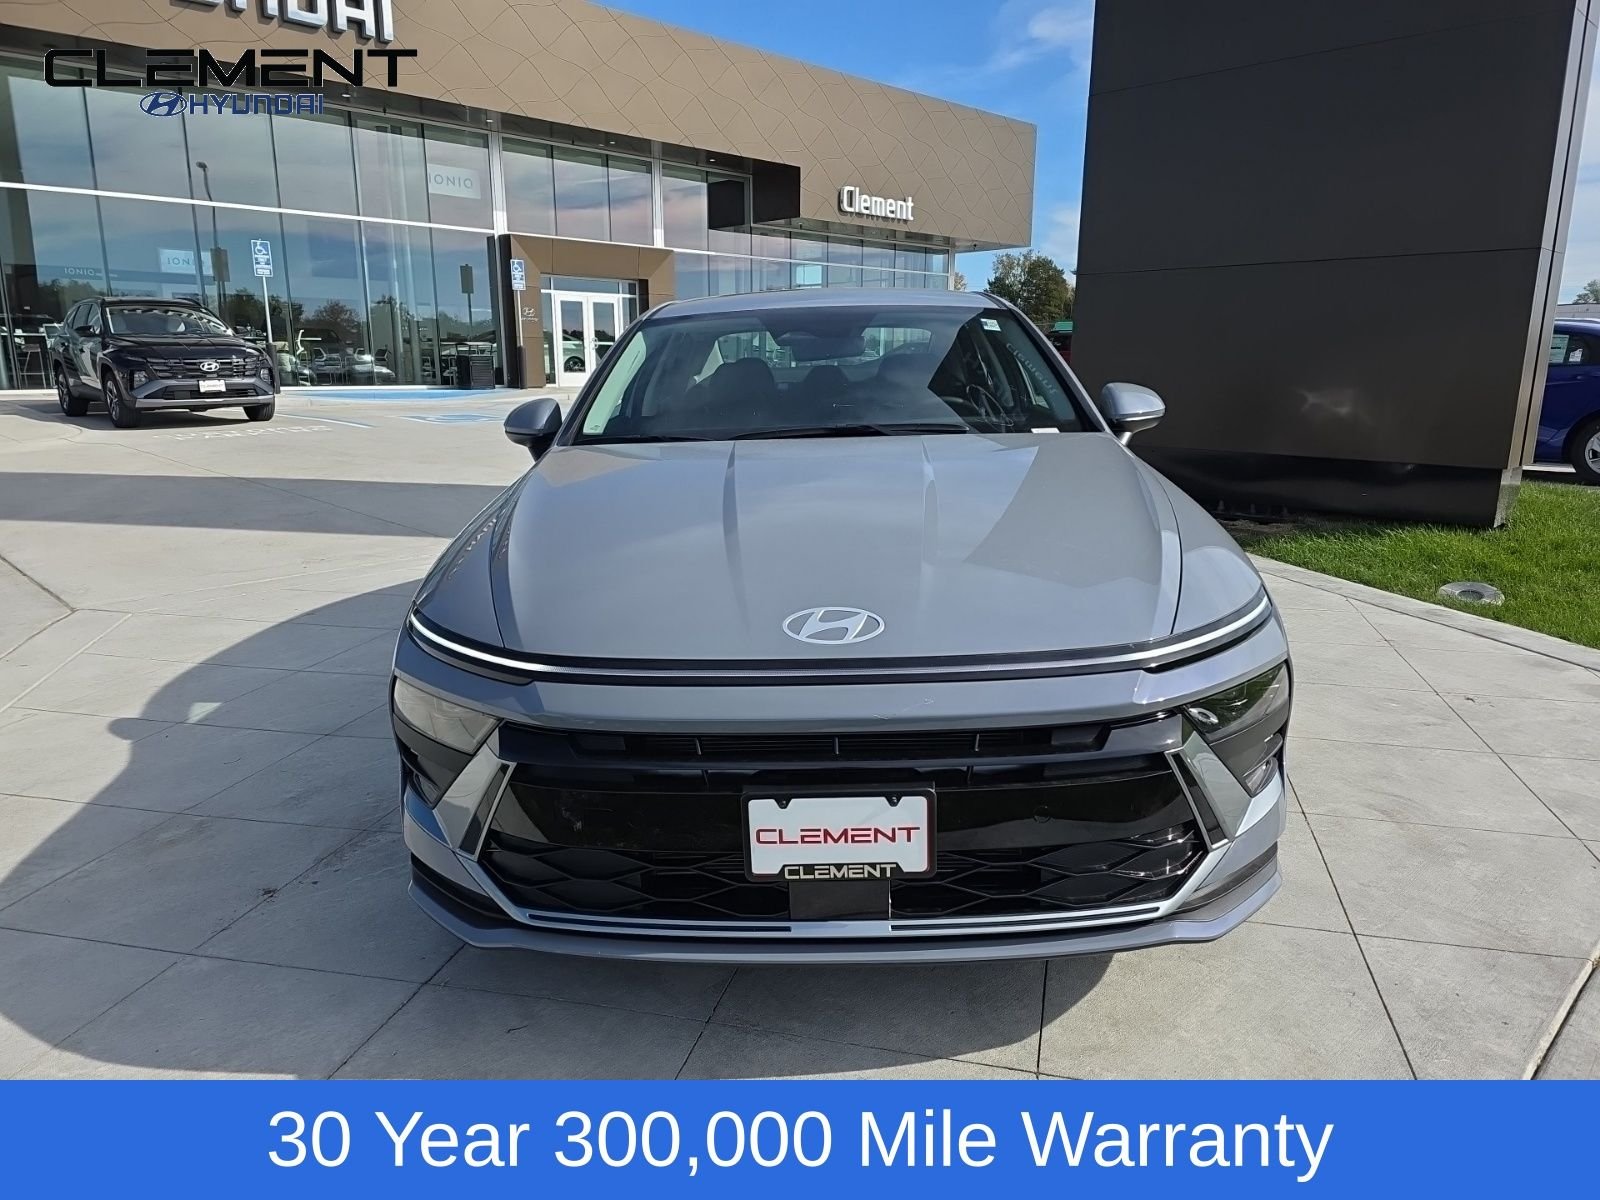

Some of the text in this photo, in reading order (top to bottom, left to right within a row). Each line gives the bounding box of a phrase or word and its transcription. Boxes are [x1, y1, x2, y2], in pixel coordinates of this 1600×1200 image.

[840, 185, 914, 221] Clement
[755, 826, 920, 845] CLEMENT
[784, 863, 897, 880] CLEMENT
